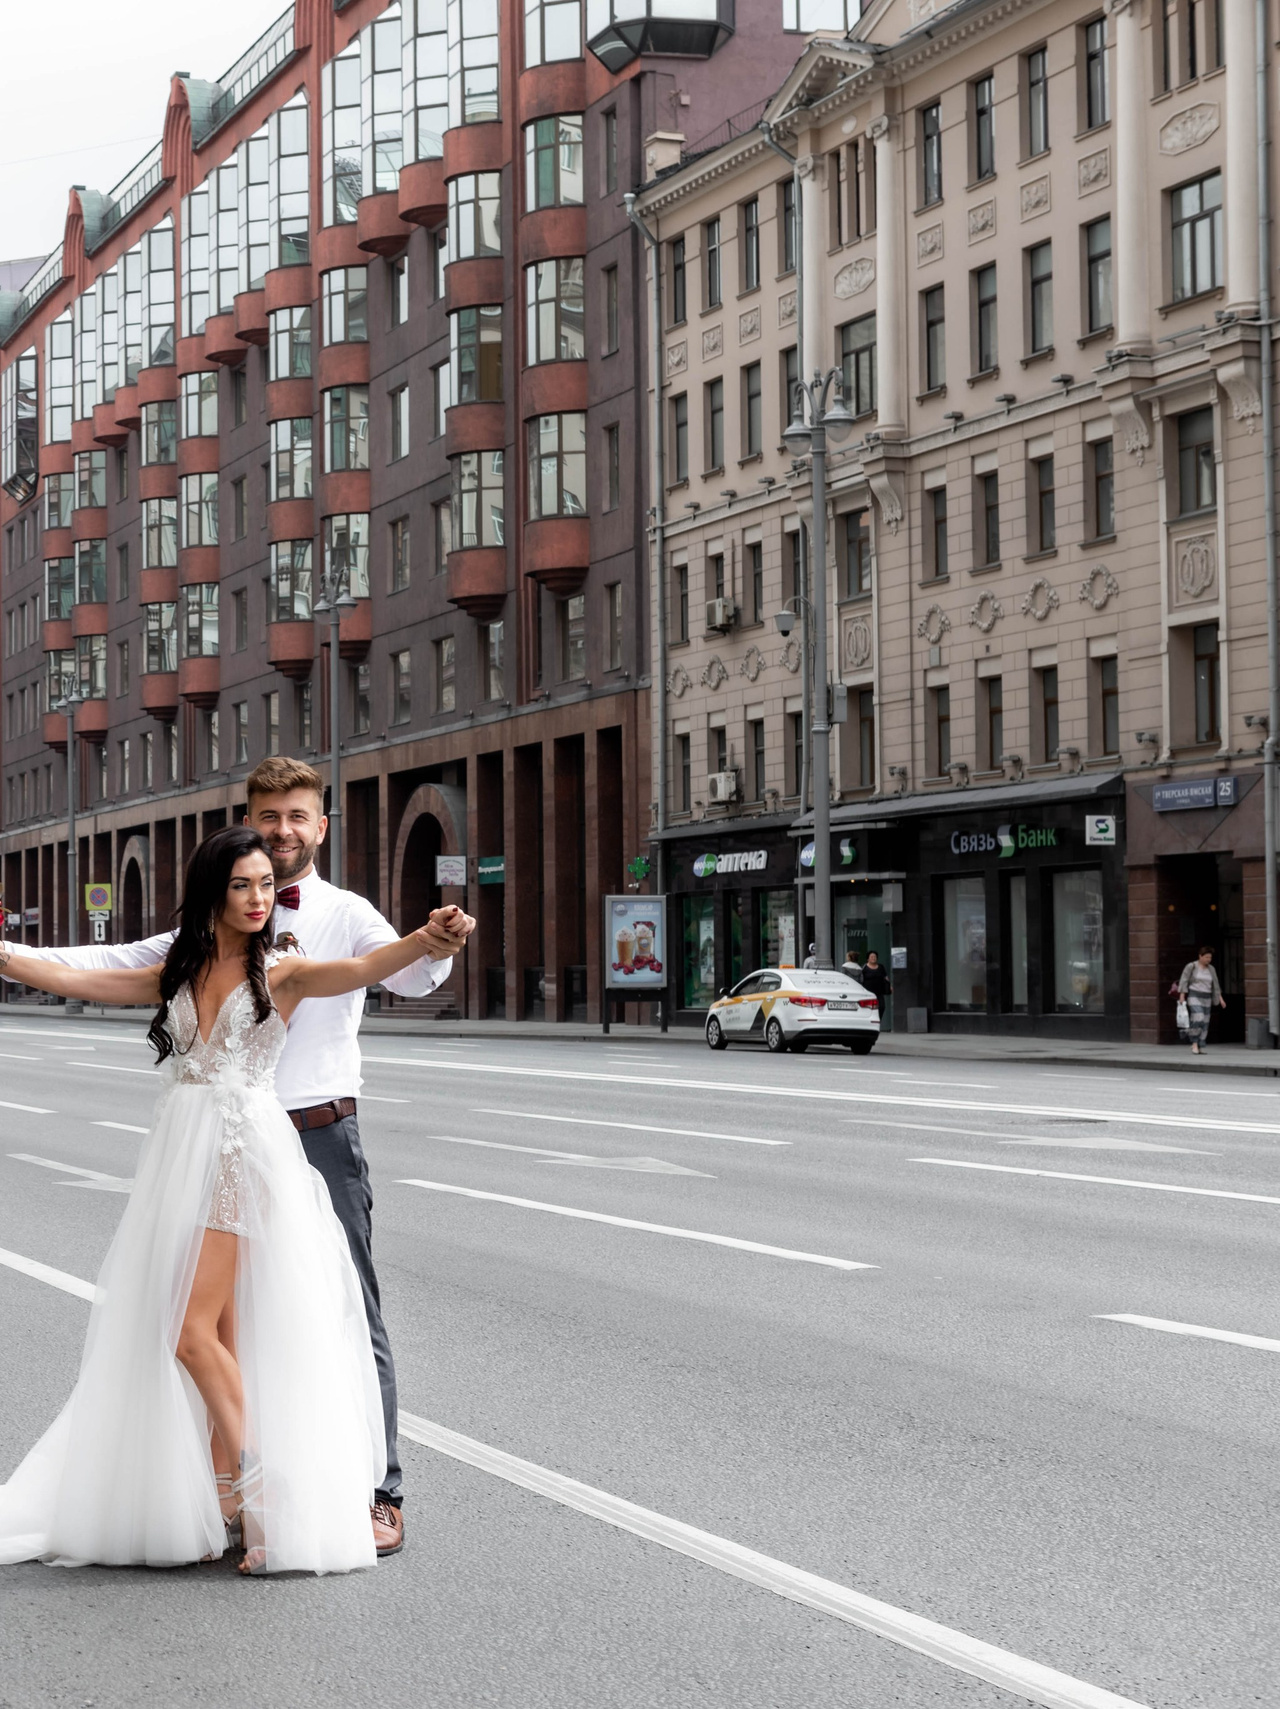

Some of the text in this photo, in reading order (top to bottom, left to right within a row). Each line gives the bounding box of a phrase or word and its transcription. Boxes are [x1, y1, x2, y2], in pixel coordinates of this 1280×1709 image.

[1220, 782, 1231, 796] 25
[951, 825, 1057, 854] Связь Банк
[716, 850, 768, 873] аптека
